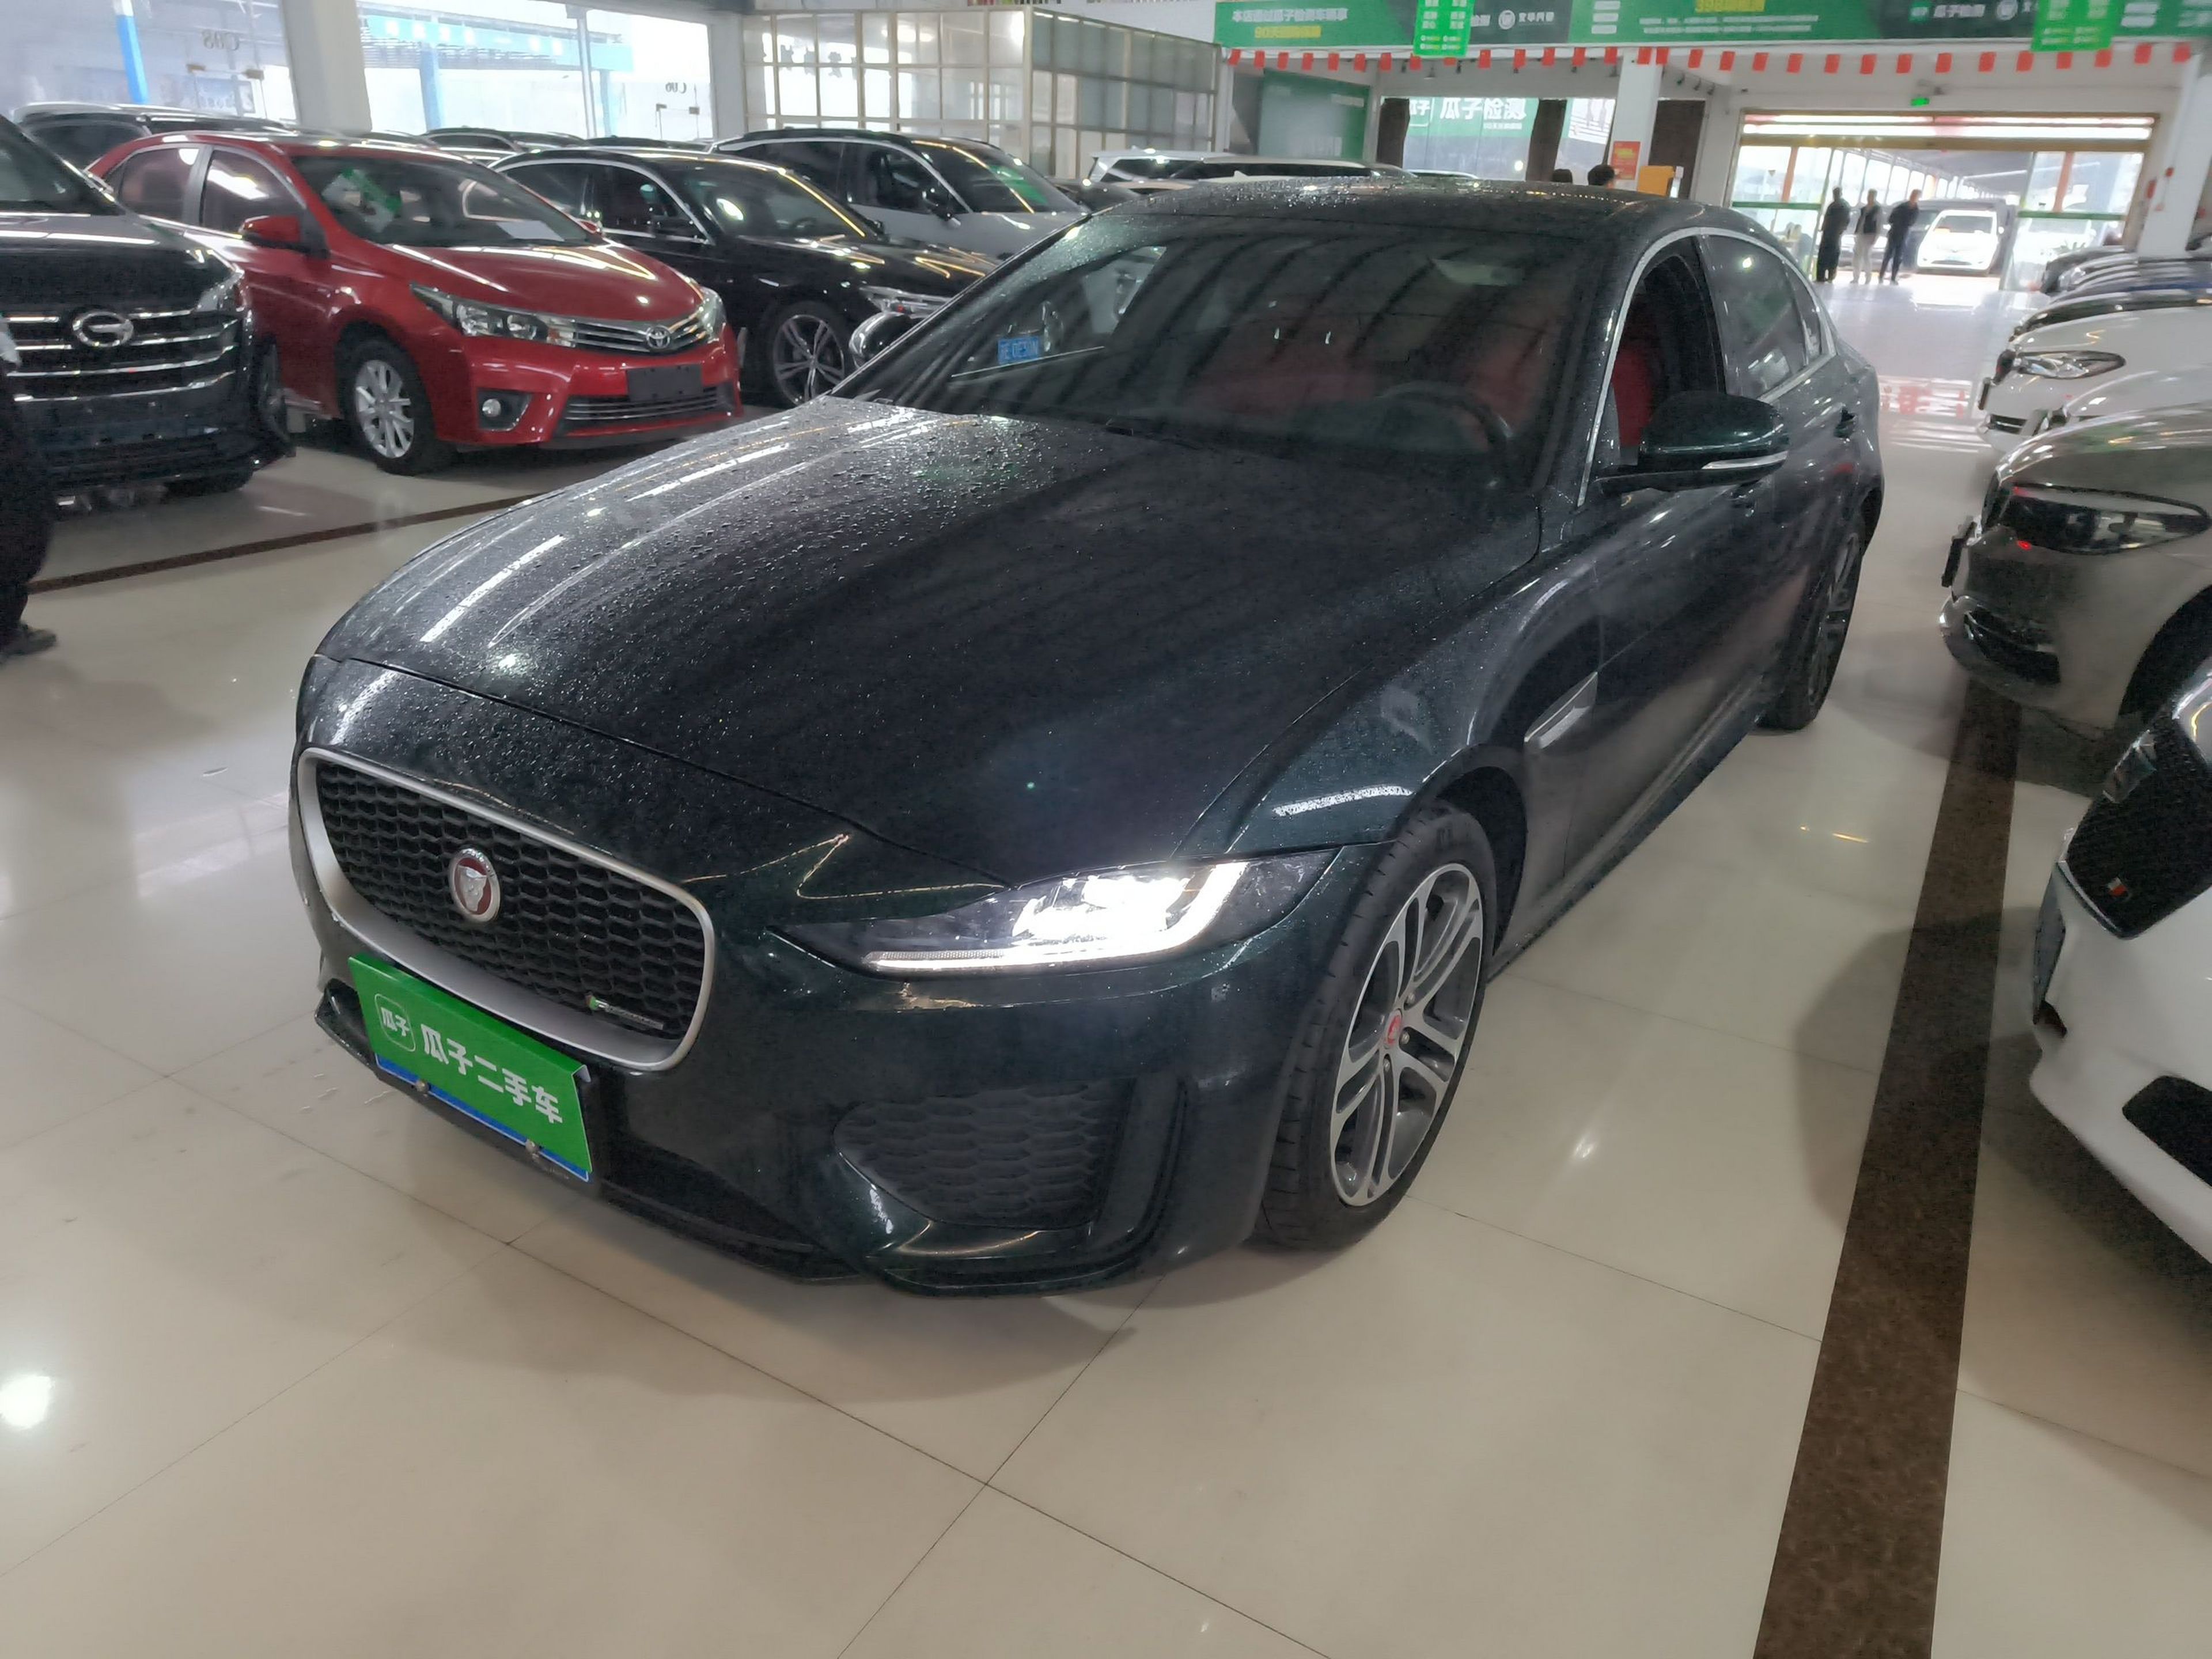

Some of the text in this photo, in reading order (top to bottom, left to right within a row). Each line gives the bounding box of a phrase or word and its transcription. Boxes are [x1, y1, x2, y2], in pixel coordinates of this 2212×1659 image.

[1440, 97, 1527, 120] 瓜子检测
[381, 1006, 411, 1037] 瓜子
[421, 1023, 563, 1124] 瓜子二手车
